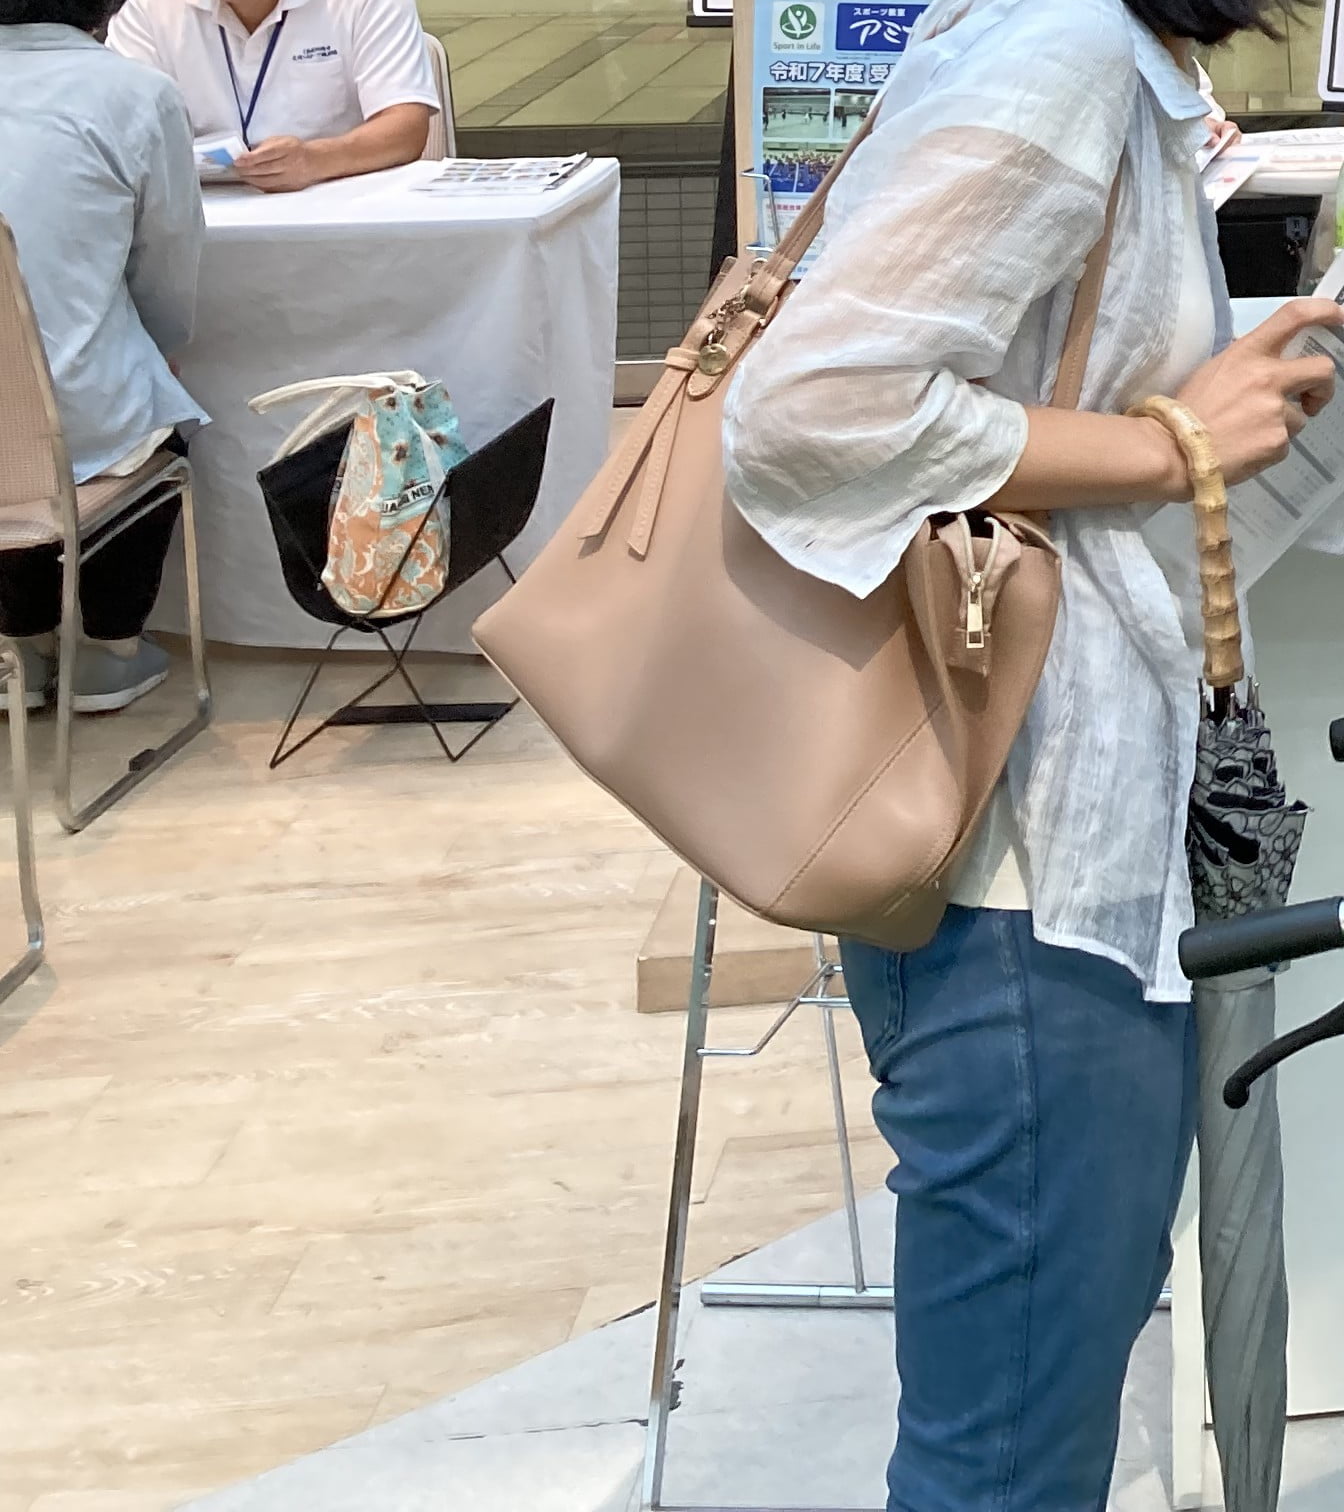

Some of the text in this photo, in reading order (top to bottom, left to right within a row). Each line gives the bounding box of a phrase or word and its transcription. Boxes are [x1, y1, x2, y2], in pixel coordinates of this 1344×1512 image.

[772, 41, 795, 51] Sport
[806, 41, 821, 51] Life
[769, 60, 865, 83] 令和7年度
